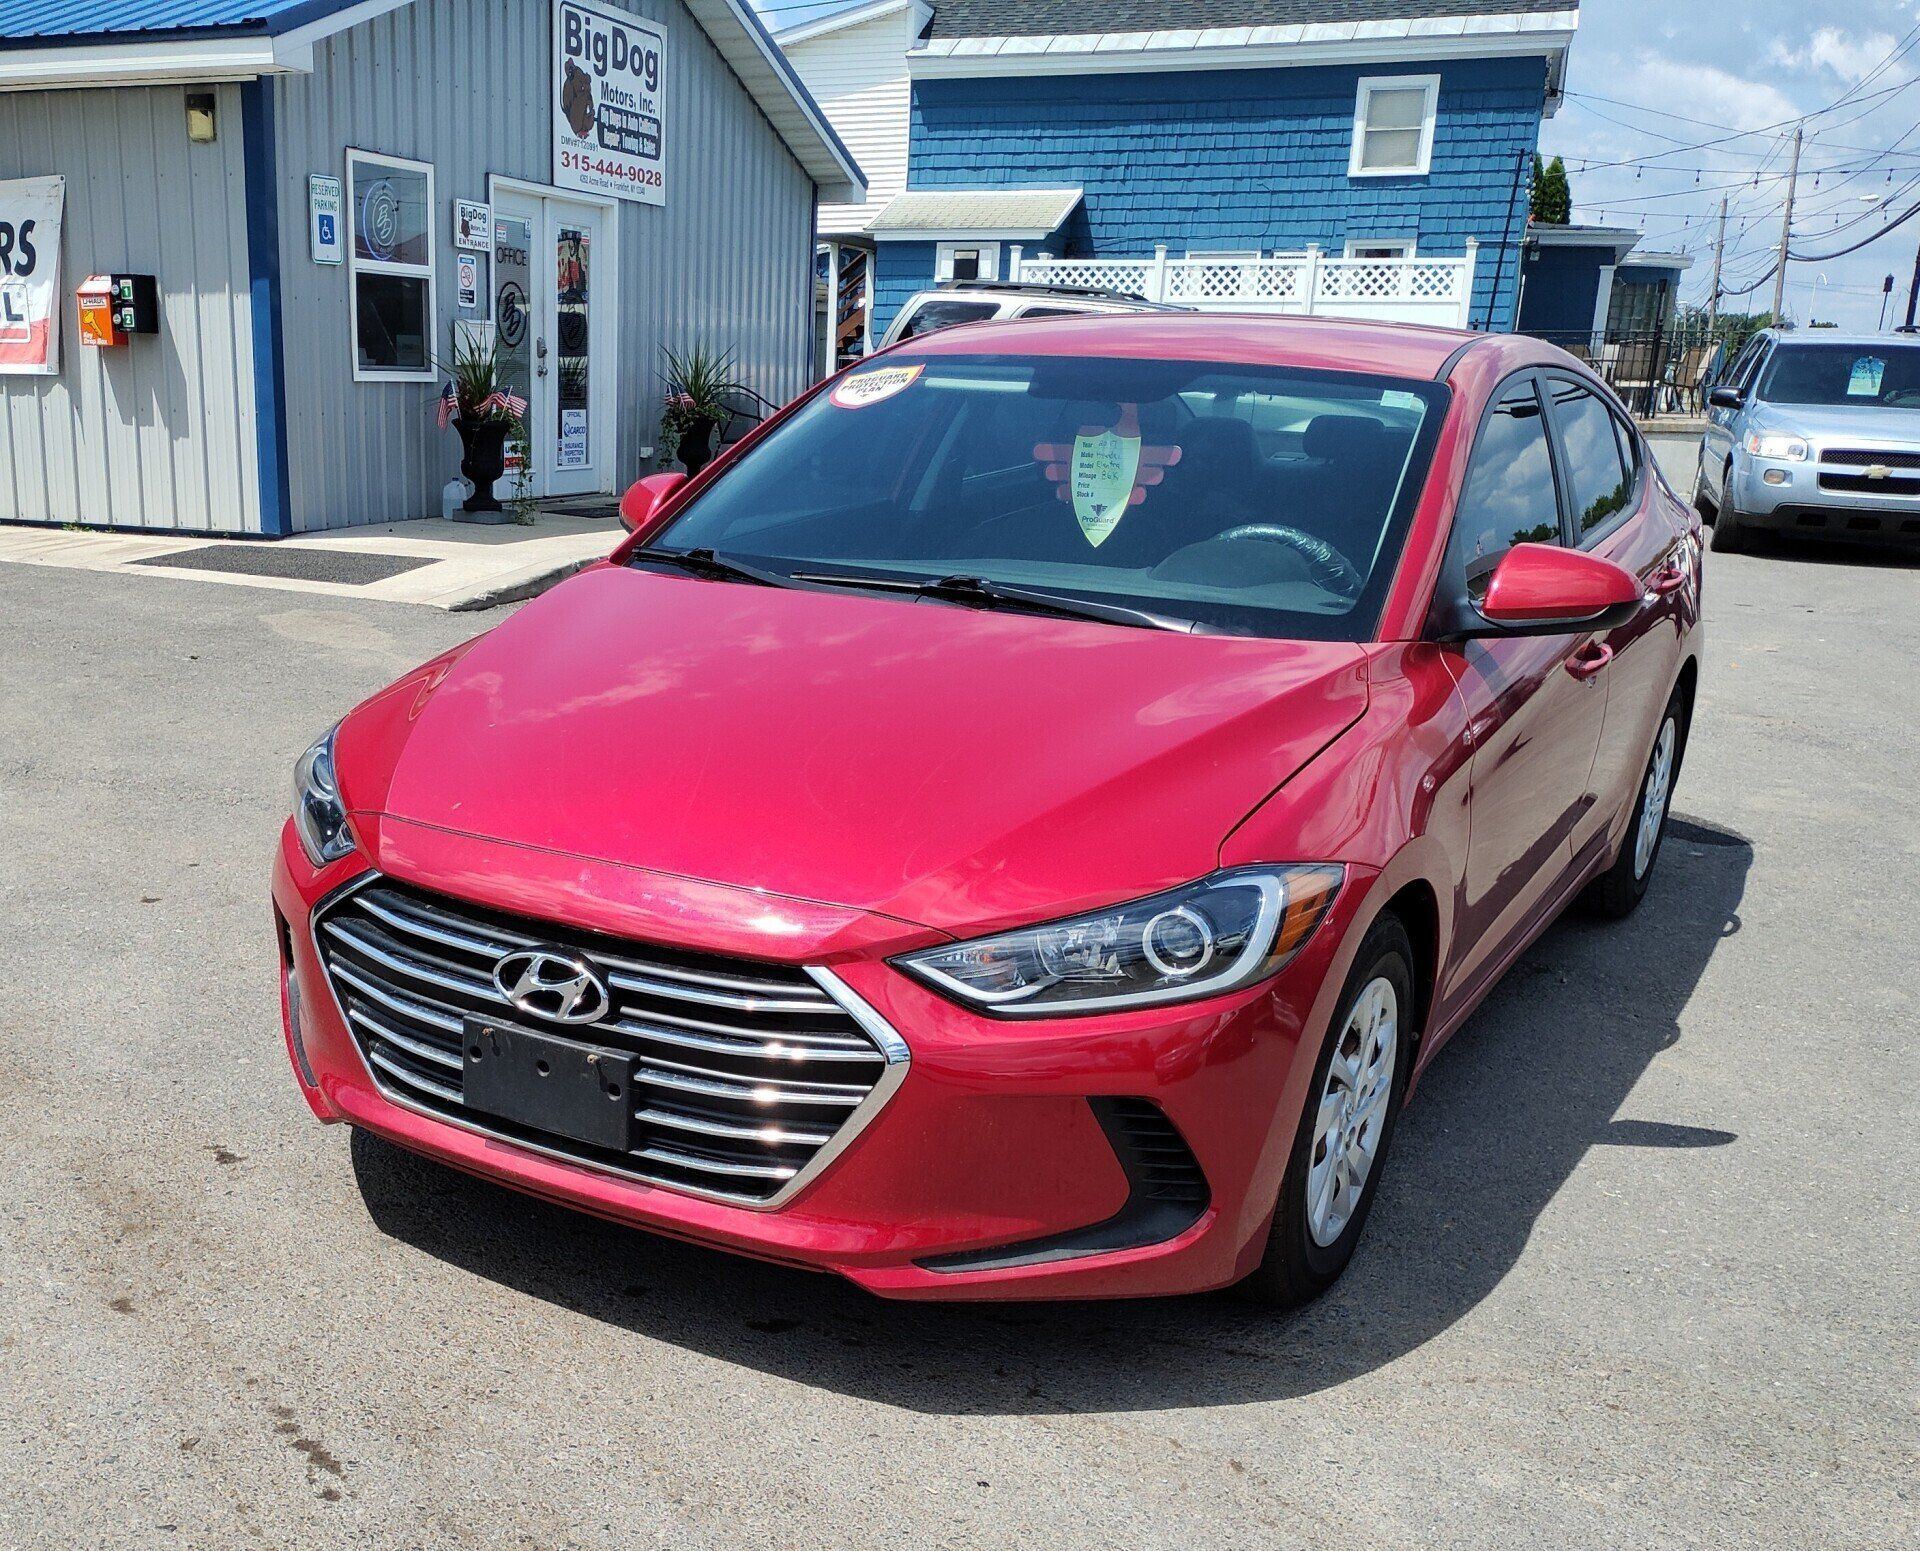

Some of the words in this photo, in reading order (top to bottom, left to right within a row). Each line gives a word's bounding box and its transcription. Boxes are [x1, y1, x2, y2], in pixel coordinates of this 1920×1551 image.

[600, 80, 637, 111] Motors,
[560, 150, 663, 188] 315-444-9028
[311, 183, 340, 197] RESERVED
[314, 198, 338, 212] PARKING
[458, 237, 490, 249] ENTRANCE
[496, 246, 528, 267] OFFICE
[82, 298, 105, 306] U-HAUL
[840, 377, 908, 391] PROTECTION
[849, 372, 909, 385] PROGUARD
[854, 386, 883, 395] PLAN
[570, 425, 586, 435] CARCO
[564, 449, 585, 457] INSPECTION
[1080, 451, 1094, 459] Make
[567, 456, 582, 464] STATION
[1078, 472, 1097, 481] Mileage
[1081, 515, 1115, 524] ProGuard
